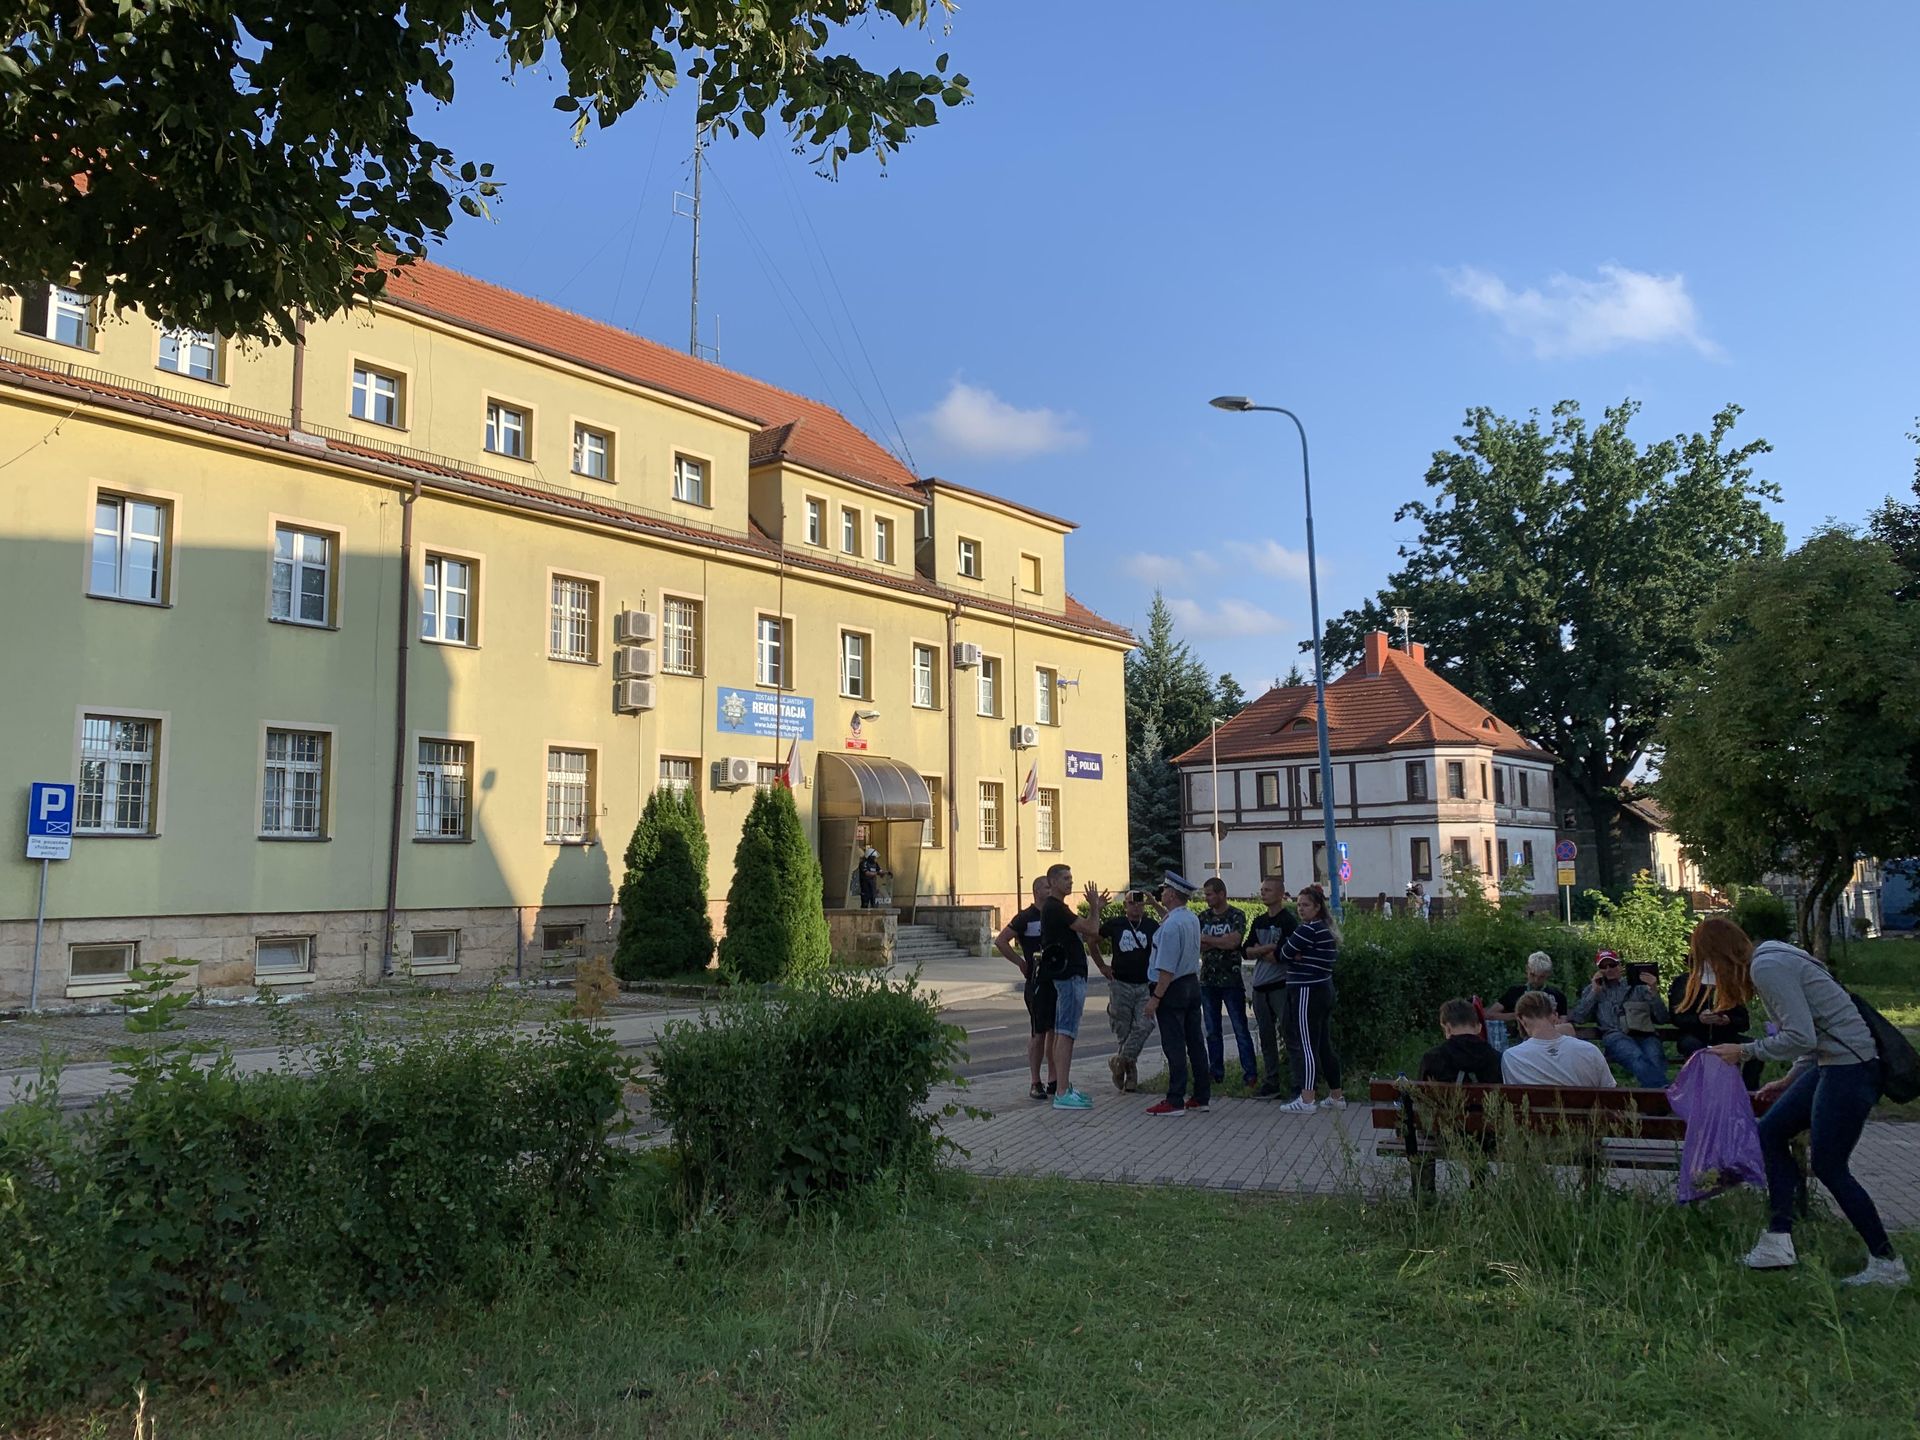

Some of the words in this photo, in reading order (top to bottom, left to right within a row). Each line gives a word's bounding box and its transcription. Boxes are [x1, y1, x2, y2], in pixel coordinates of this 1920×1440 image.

[775, 695, 804, 705] PLICJANTEM
[1080, 761, 1100, 771] POLICJA
[40, 787, 66, 820] P
